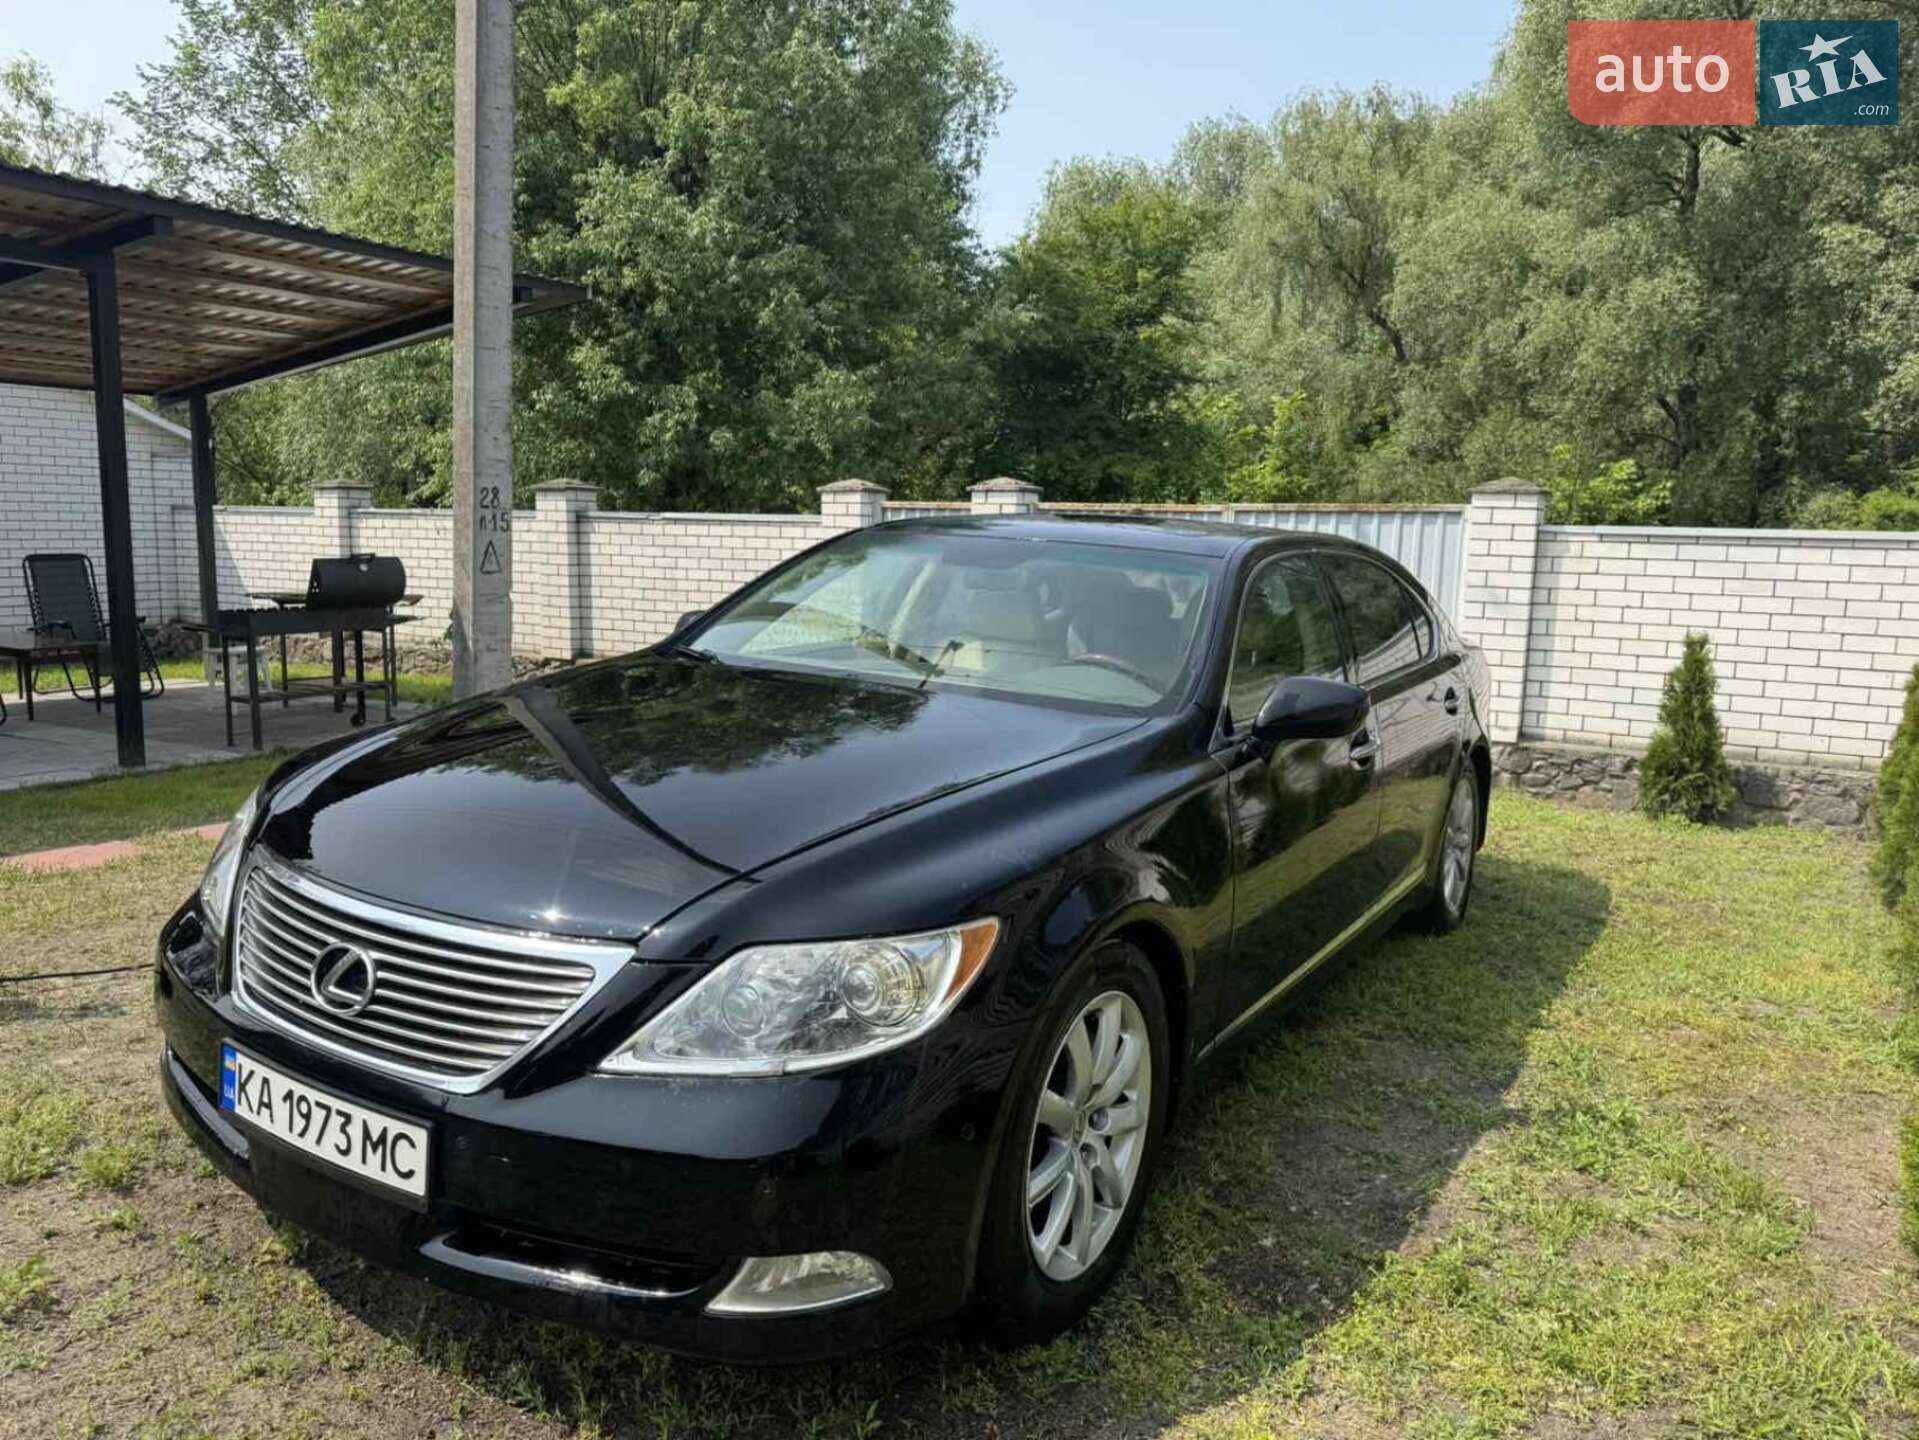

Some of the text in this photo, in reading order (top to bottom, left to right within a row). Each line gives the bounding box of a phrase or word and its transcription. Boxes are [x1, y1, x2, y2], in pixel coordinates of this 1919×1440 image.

[480, 486, 500, 509] 28
[237, 1062, 417, 1180] KA 1973 MC
